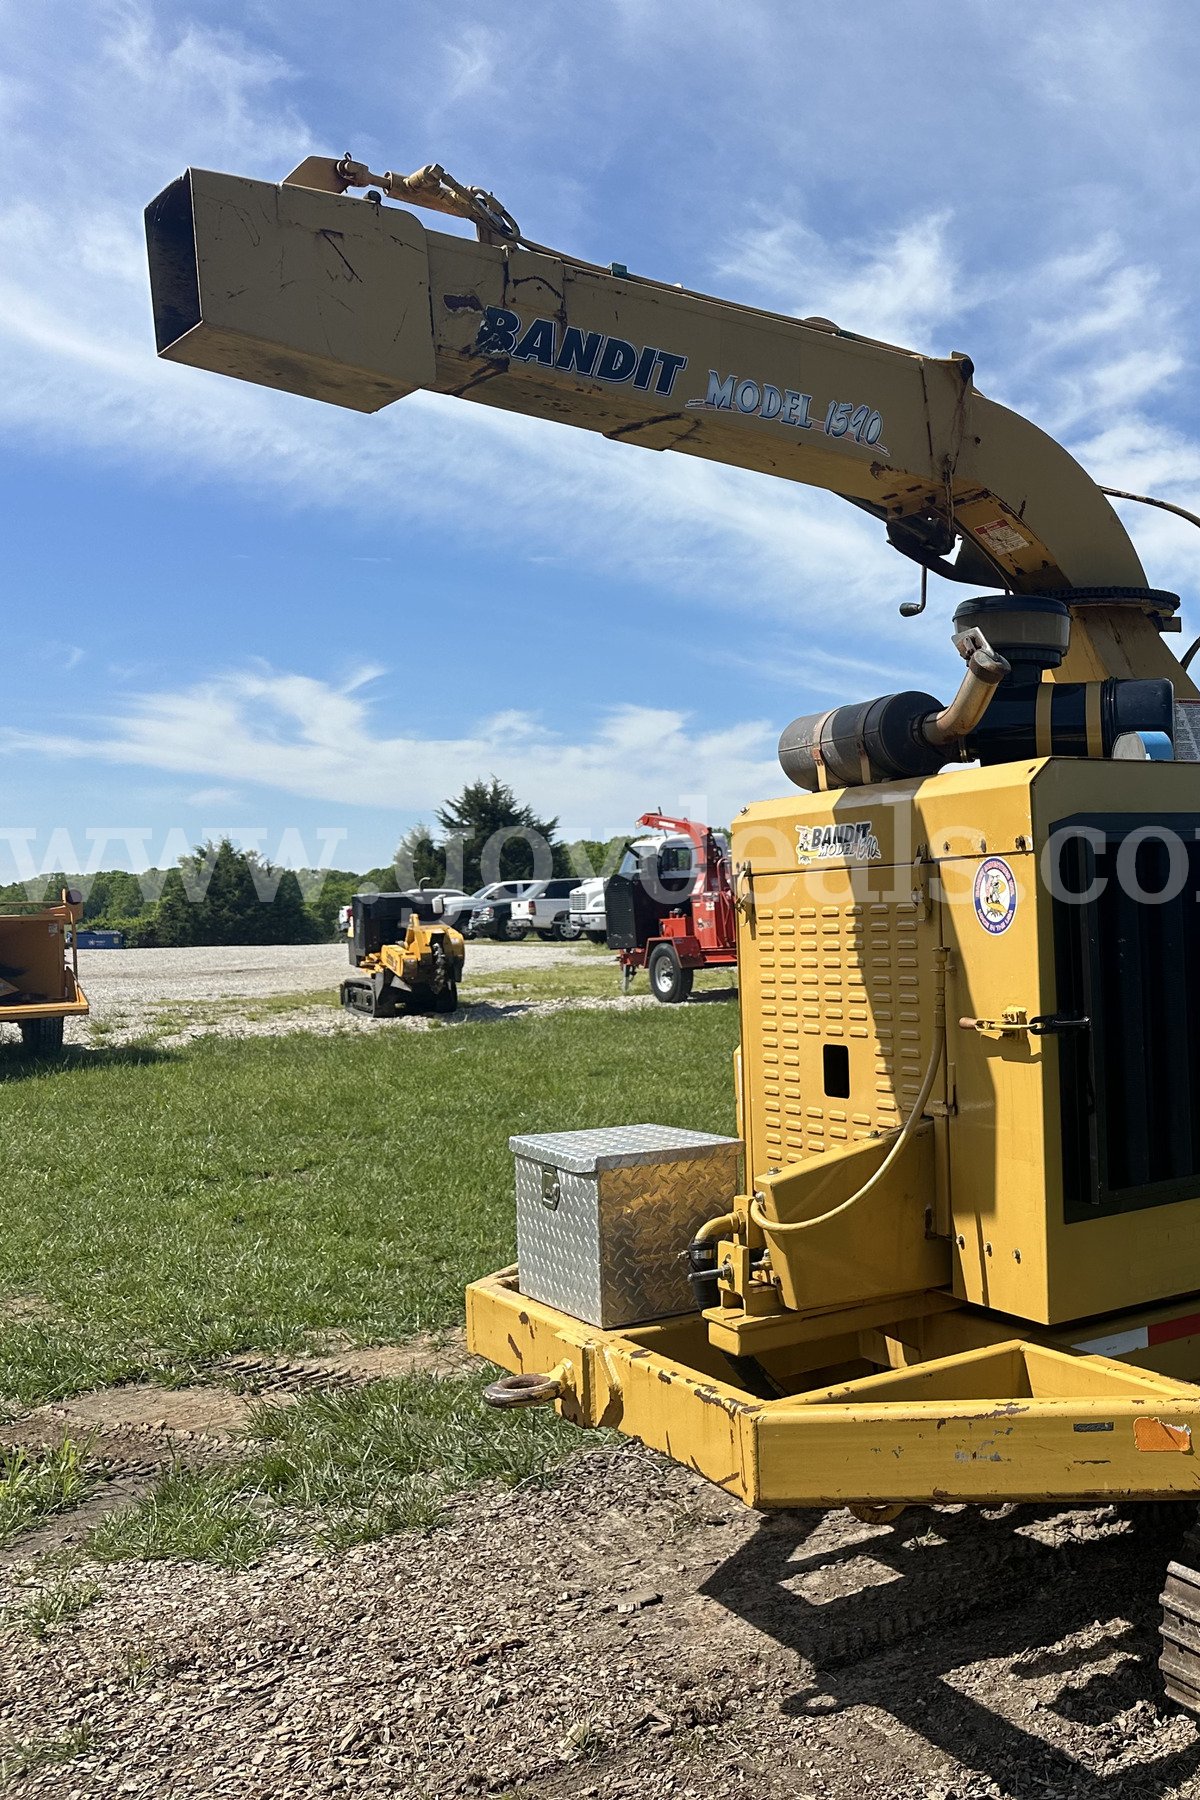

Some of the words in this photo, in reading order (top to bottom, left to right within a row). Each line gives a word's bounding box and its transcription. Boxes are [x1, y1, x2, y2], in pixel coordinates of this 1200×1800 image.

[477, 305, 688, 396] BANDIT
[704, 369, 813, 429] MODEL
[824, 399, 885, 447] 1590
[811, 822, 872, 848] BANDIT
[818, 842, 856, 857] MODEL
